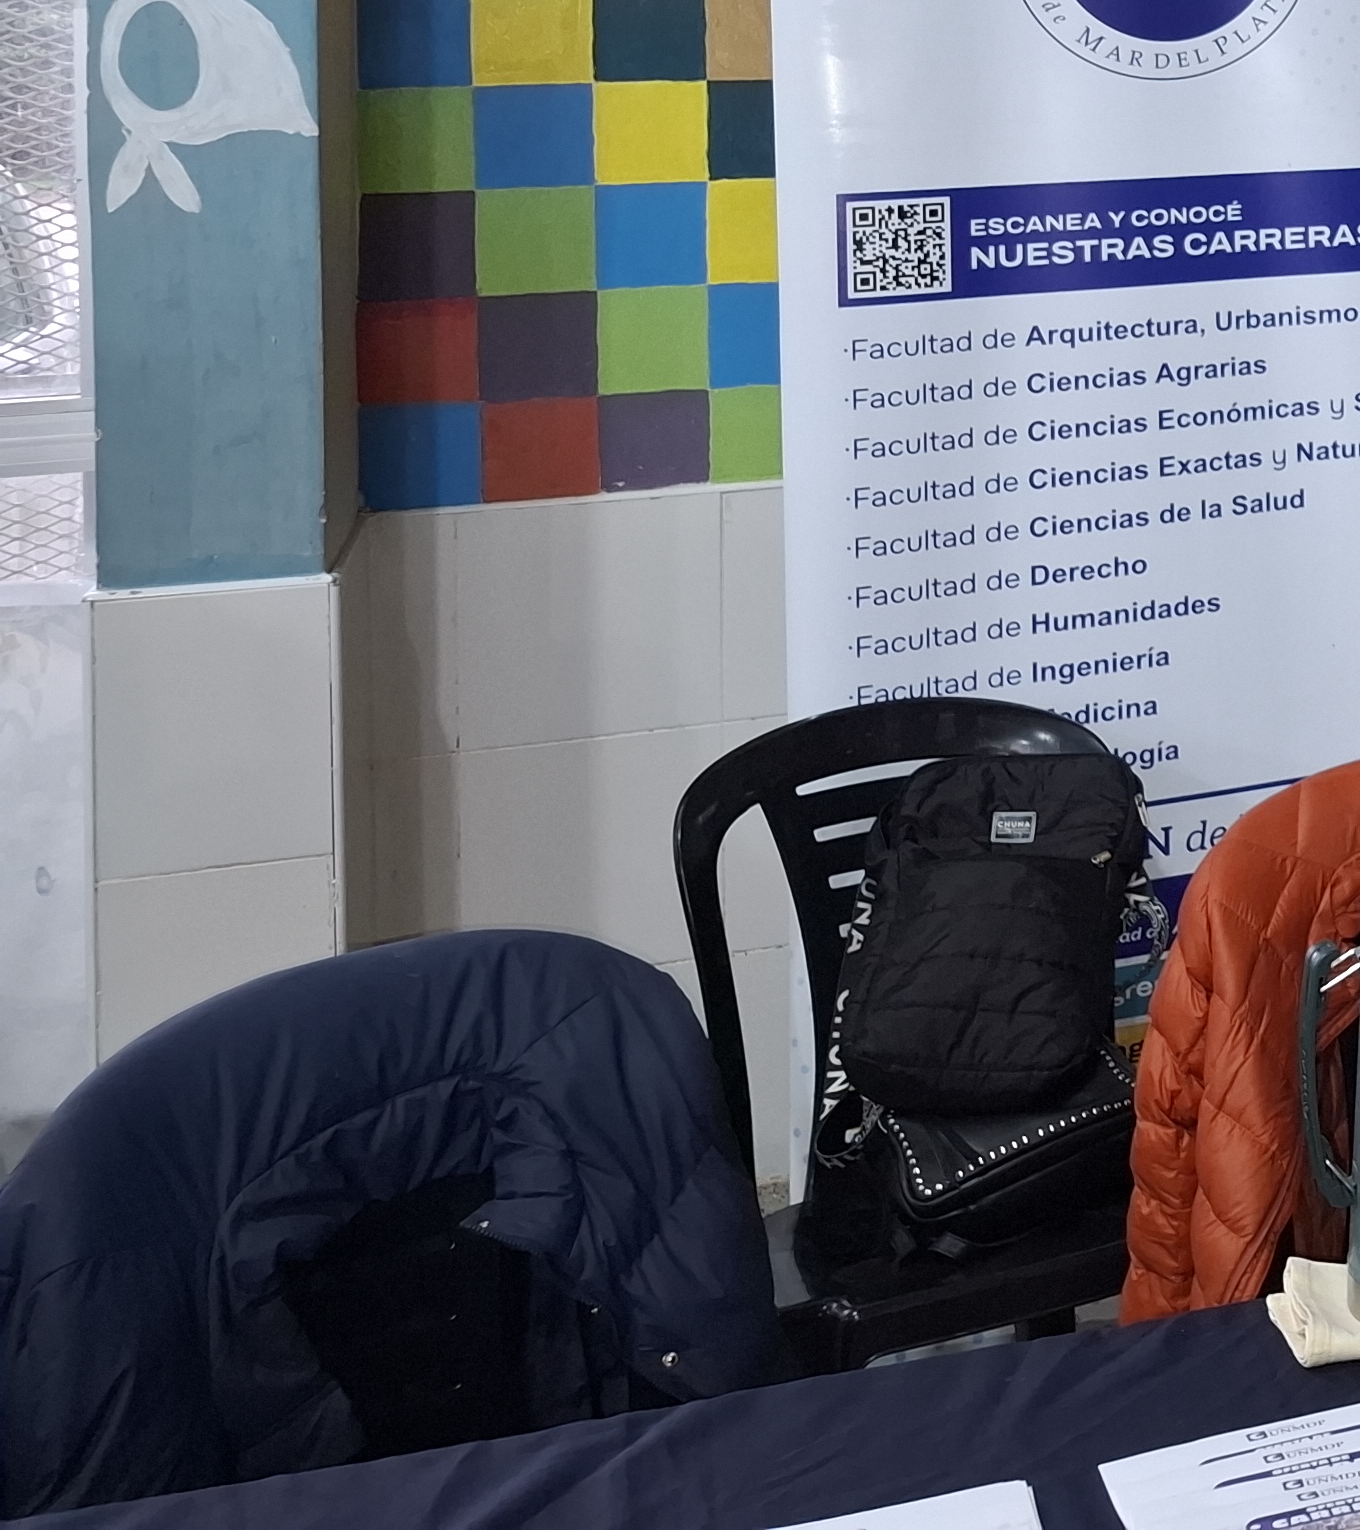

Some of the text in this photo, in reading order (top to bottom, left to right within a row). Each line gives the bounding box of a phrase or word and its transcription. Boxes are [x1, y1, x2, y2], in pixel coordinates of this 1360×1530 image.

[1042, 0, 1066, 25] de
[1075, 26, 1144, 69] MAR
[1154, 48, 1209, 69] DEL
[970, 200, 1243, 237] ESCANEA Y CONOCÉ
[970, 235, 1175, 270] NUESTRAS
[982, 327, 1016, 352] de
[1025, 314, 1206, 350] Arquitectura,
[1215, 302, 1359, 331] Urbanismo
[982, 376, 1017, 399] de
[1027, 364, 1147, 394] Ciencias
[1156, 354, 1268, 386] Agrarias
[984, 424, 1018, 448] de
[1027, 412, 1148, 442] Ciencias
[1158, 397, 1320, 430] Económicas
[1330, 399, 1346, 420] y
[985, 472, 1019, 497] de
[1028, 460, 1149, 491] Ciencias
[1158, 448, 1263, 477] Exactas
[1271, 450, 1287, 471] y
[985, 520, 1020, 545] de
[1029, 507, 1150, 539] Ciencias
[1159, 501, 1191, 525] de
[1200, 498, 1223, 520] la
[1231, 487, 1305, 516] Salud
[986, 569, 1021, 594] de
[1030, 554, 1148, 588] Derecho
[987, 617, 1022, 642] de
[1030, 593, 1222, 636] Humanidades
[987, 666, 1022, 690] de
[1031, 646, 1171, 689] Ingeniería
[997, 820, 1031, 829] CHUNA
